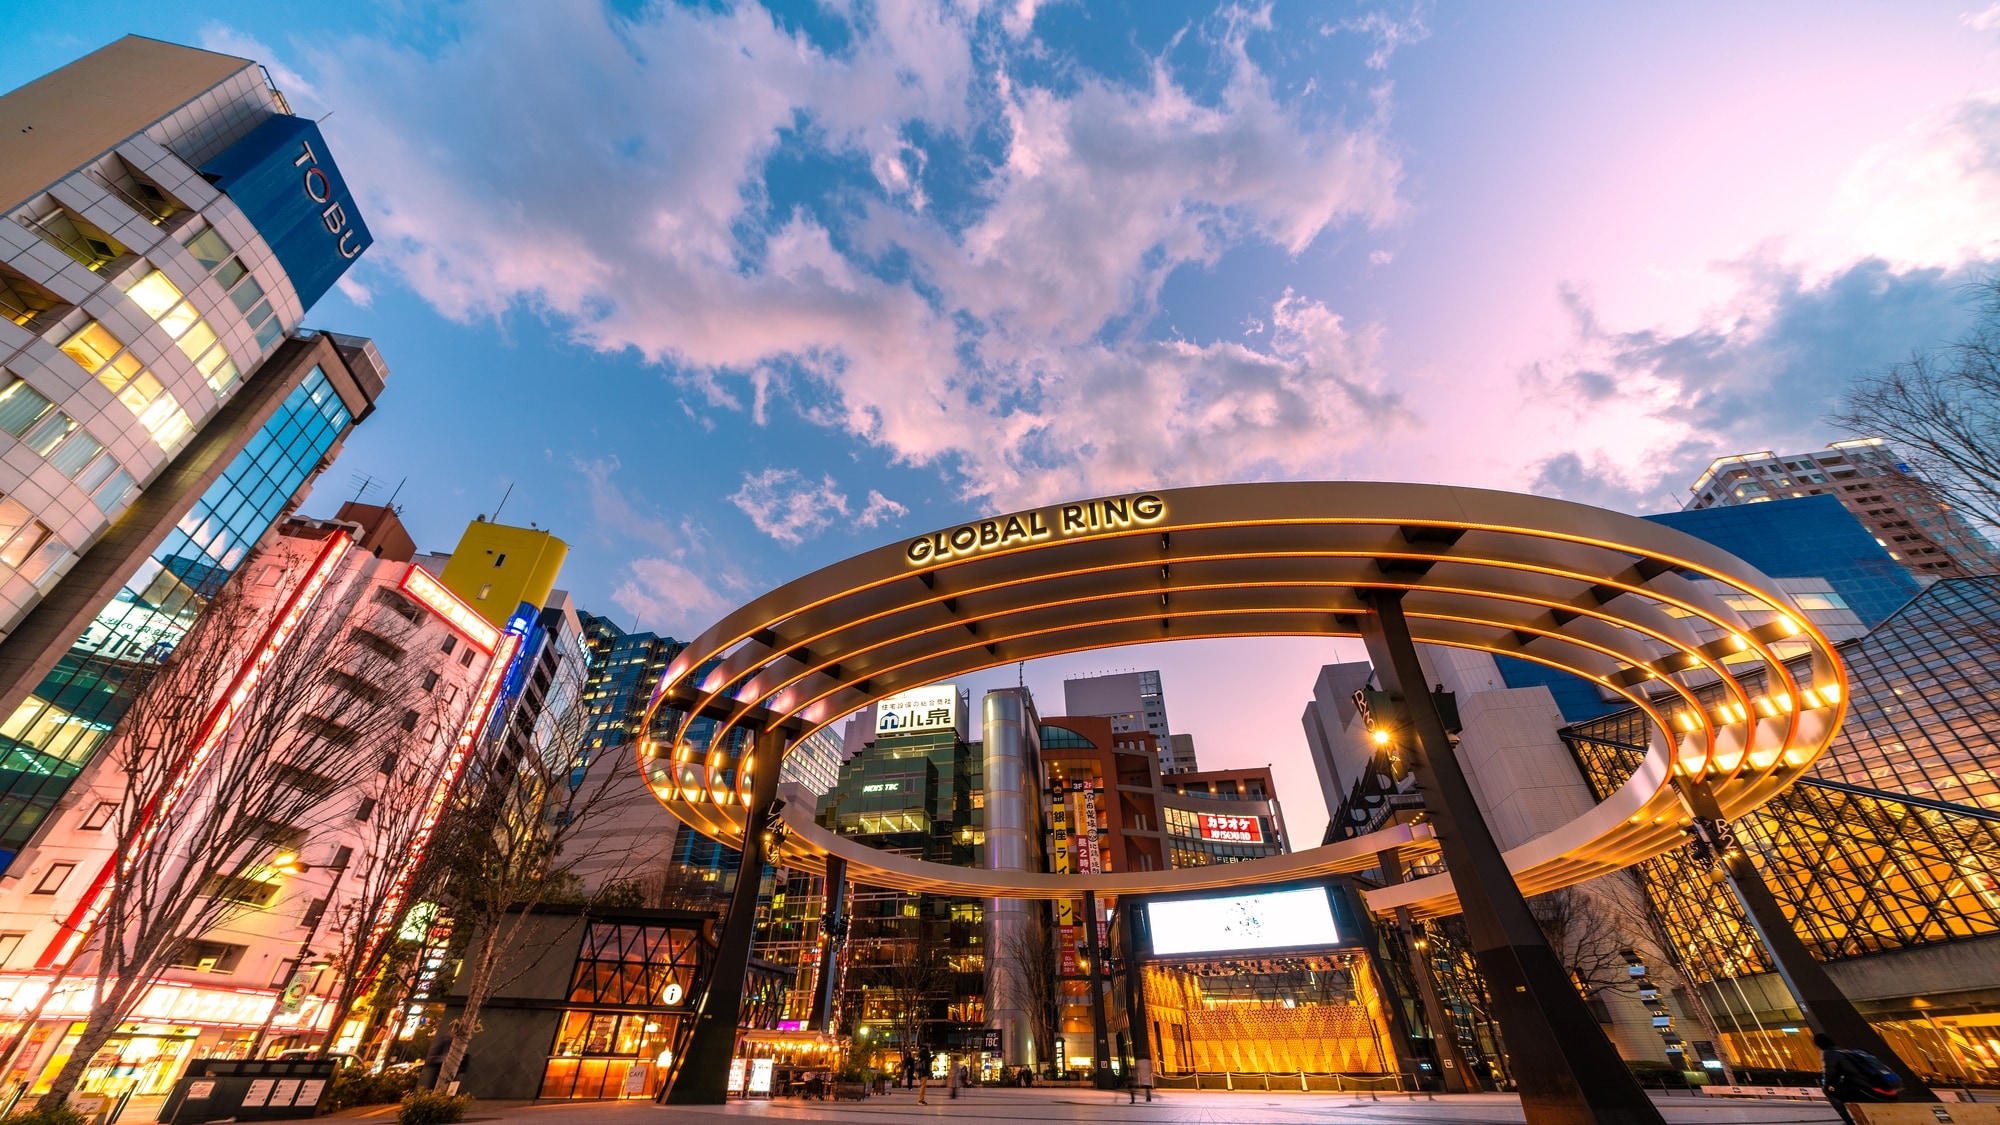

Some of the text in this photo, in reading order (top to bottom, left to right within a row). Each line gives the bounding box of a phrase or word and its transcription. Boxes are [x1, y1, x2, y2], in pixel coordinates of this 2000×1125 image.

[294, 140, 361, 259] TOBU
[907, 494, 1164, 562] GLOBAL RING
[899, 708, 951, 728] 小泉
[884, 783, 899, 791] TBC
[1073, 782, 1083, 790] 3F
[1083, 781, 1093, 789] 2F
[1207, 817, 1251, 831] カラオケ
[171, 991, 259, 1023] カラオケ
[985, 1037, 999, 1047] TBC
[629, 1069, 645, 1078] CAFÉ
